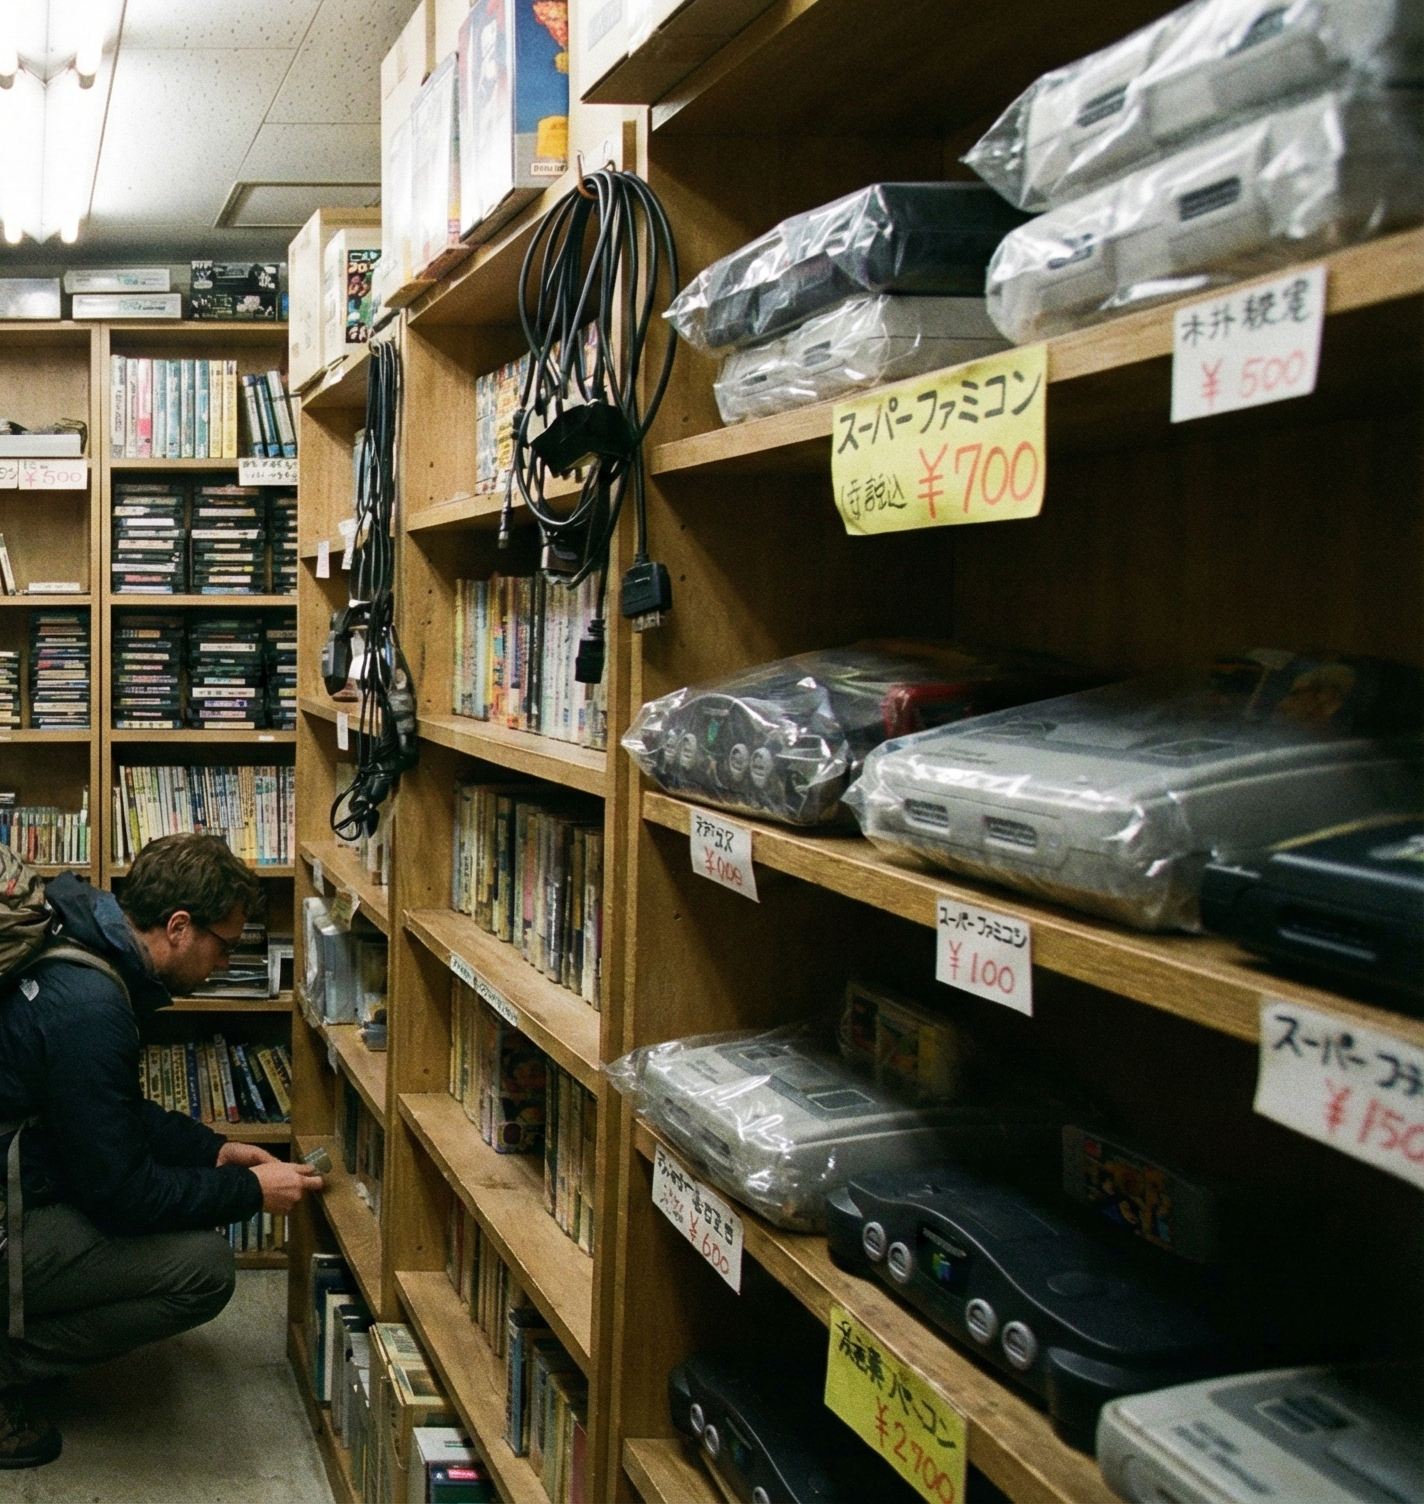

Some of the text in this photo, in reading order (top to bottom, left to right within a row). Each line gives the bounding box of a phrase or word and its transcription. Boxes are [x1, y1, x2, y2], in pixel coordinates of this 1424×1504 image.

[1201, 349, 1307, 409] ¥500
[837, 370, 1042, 454] スーパーファミコン
[26, 469, 83, 488] ¥500
[918, 440, 1039, 519] ¥700
[949, 940, 1015, 995] ¥100
[690, 1211, 730, 1275] ¥600
